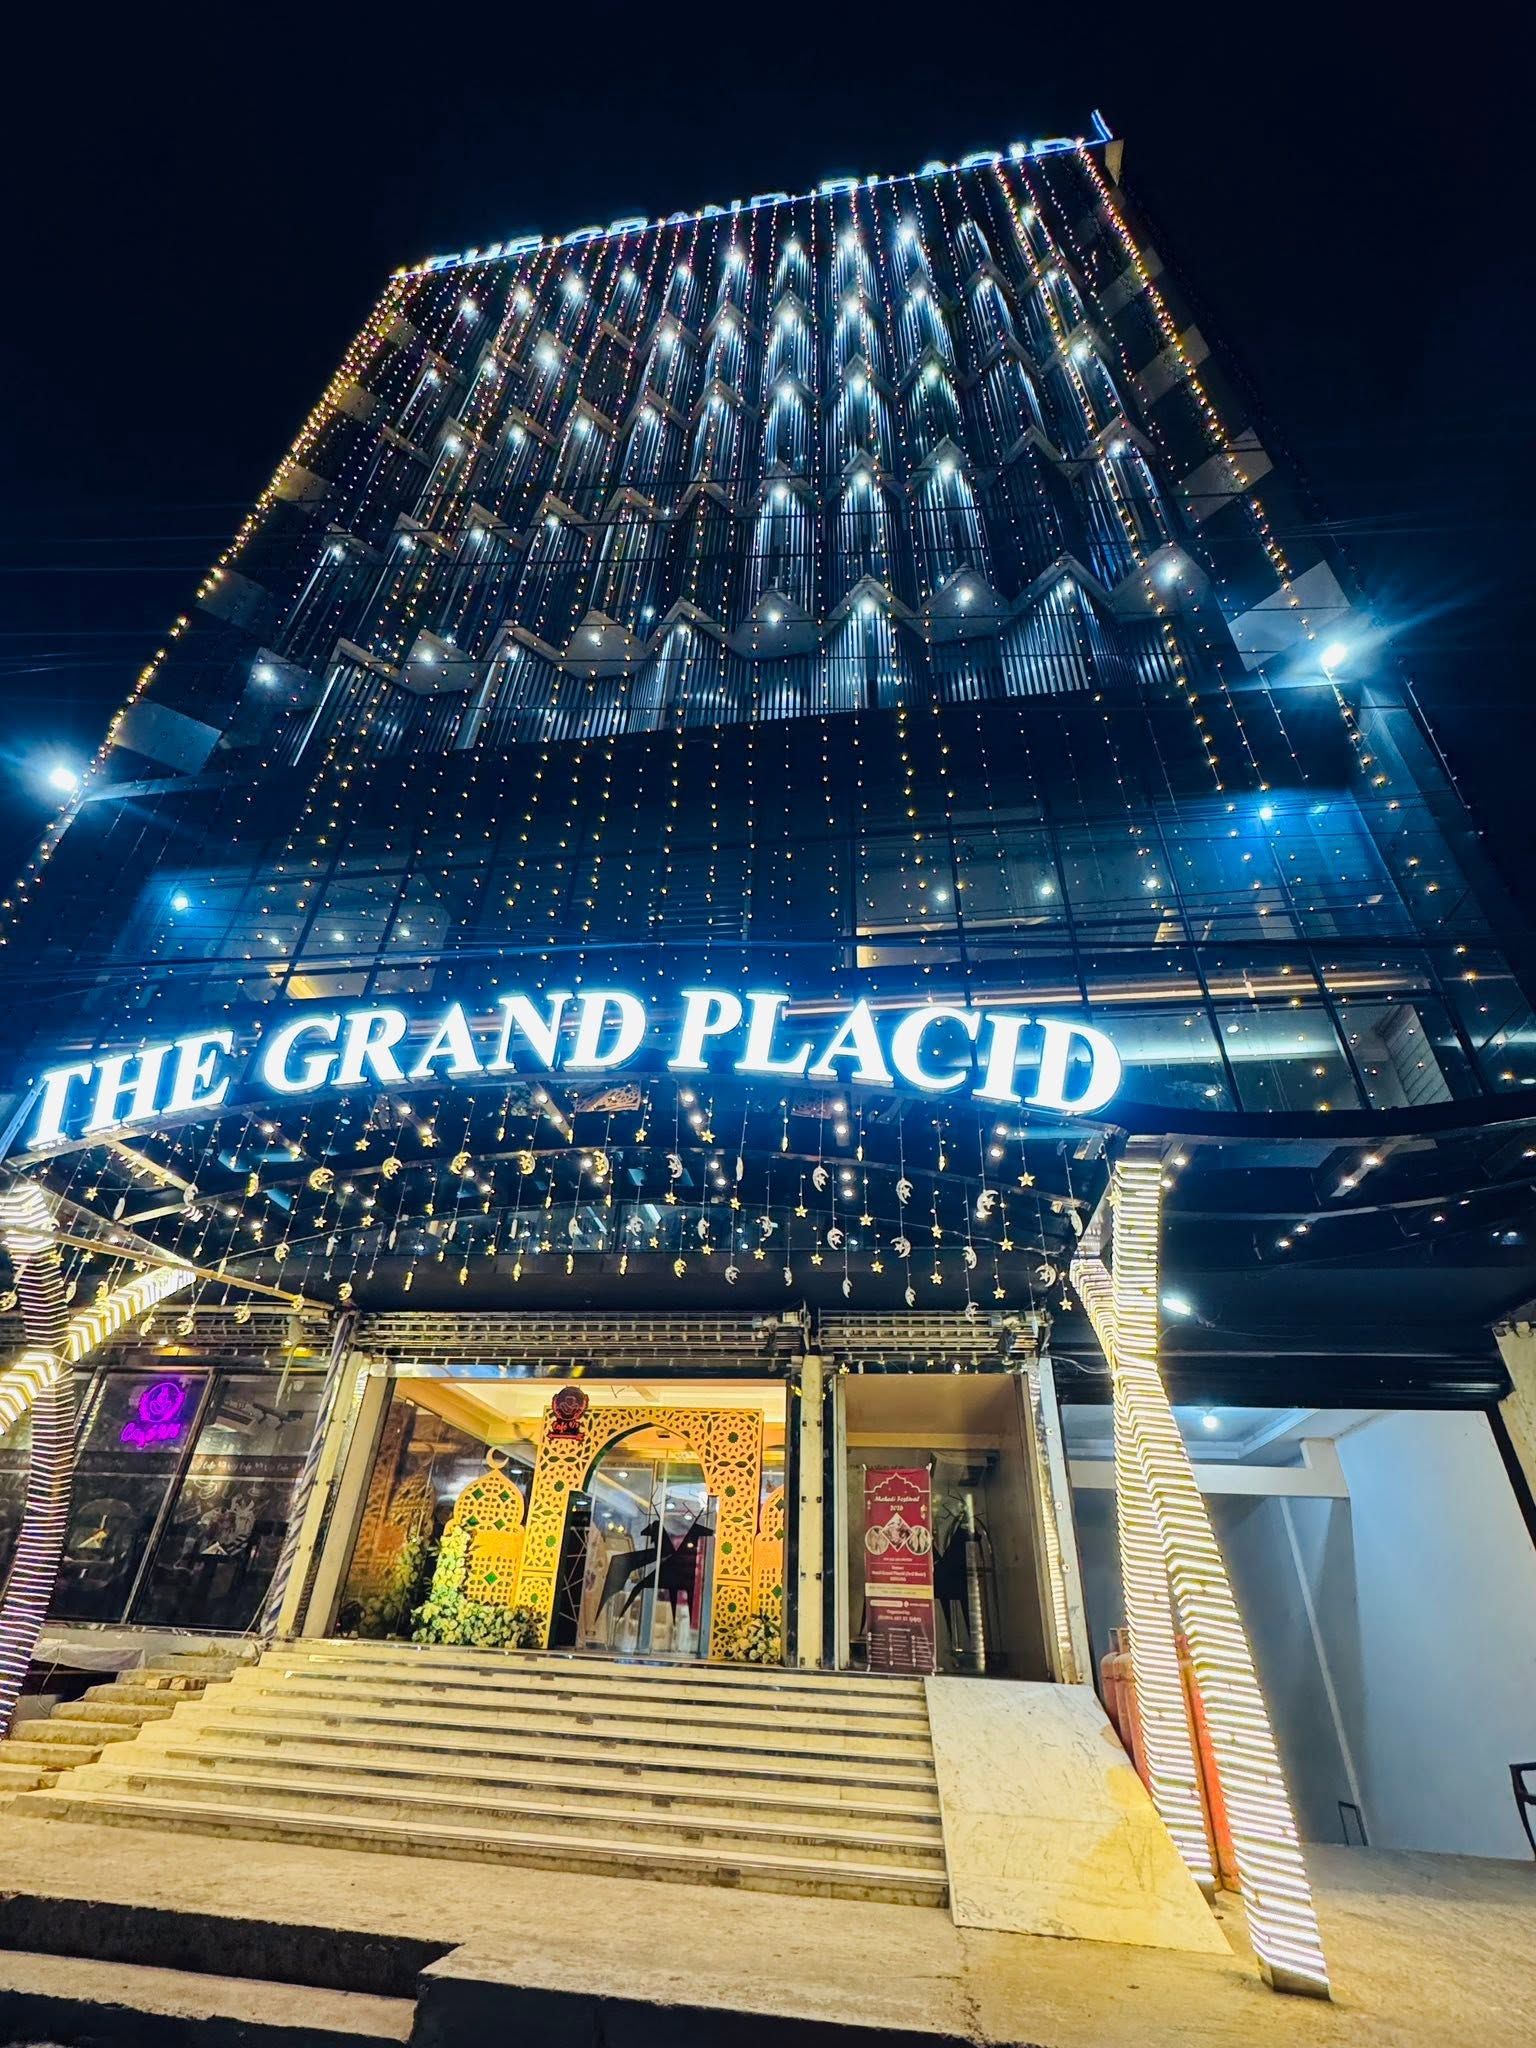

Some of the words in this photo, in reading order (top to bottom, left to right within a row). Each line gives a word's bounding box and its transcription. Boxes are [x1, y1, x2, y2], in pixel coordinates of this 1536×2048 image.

[27, 1028, 235, 1147] THE
[263, 990, 647, 1094] GRAND
[667, 989, 1122, 1113] PLACID
